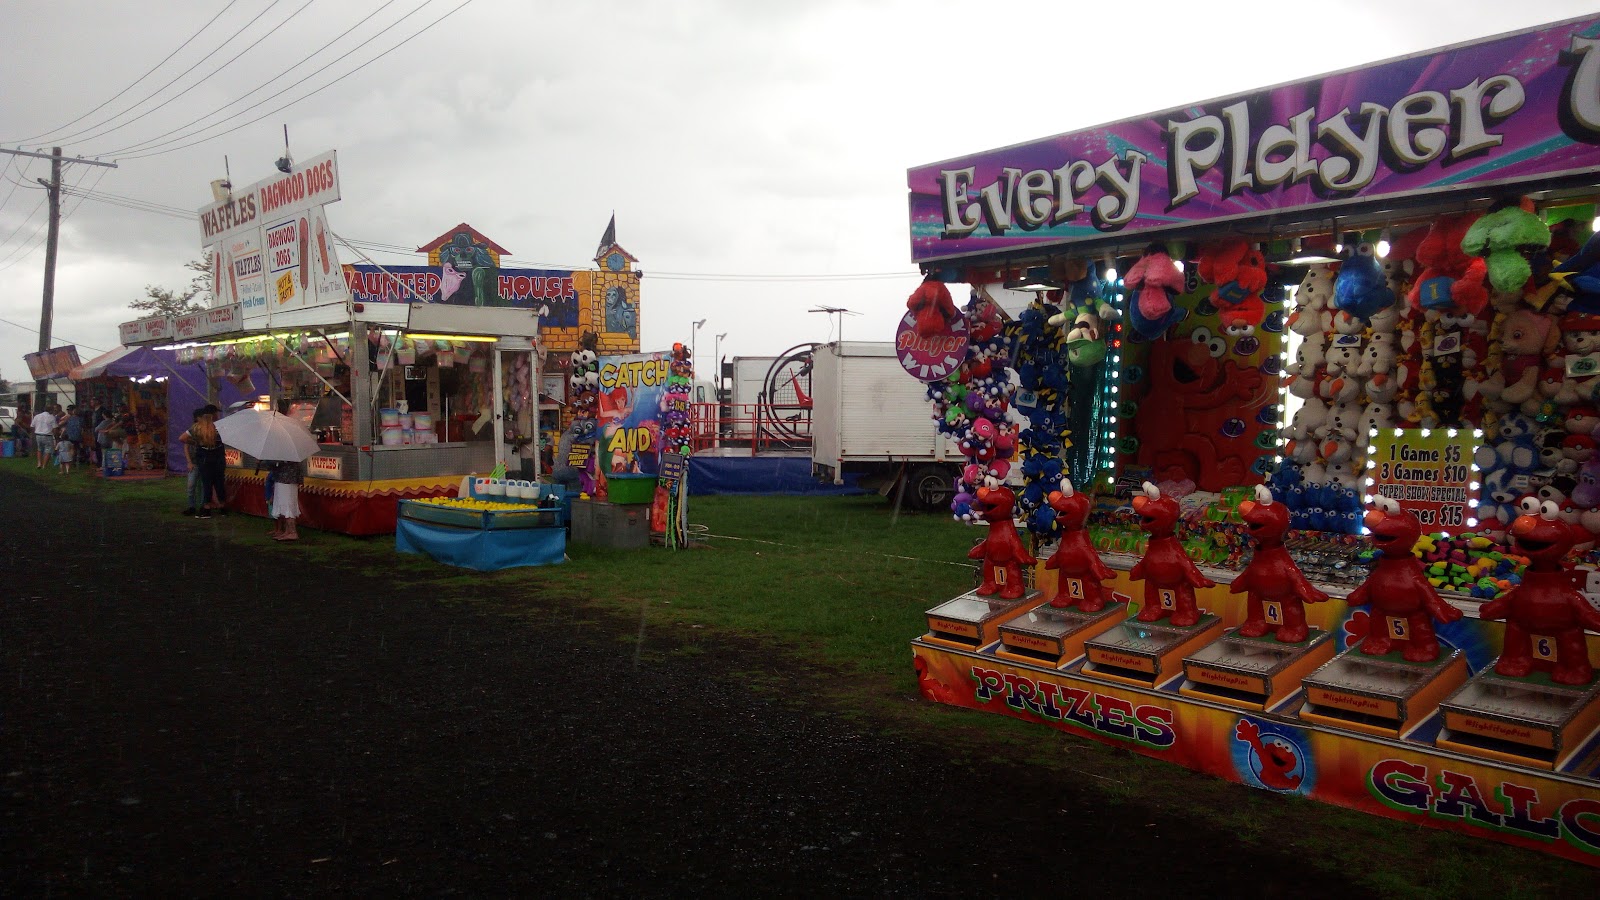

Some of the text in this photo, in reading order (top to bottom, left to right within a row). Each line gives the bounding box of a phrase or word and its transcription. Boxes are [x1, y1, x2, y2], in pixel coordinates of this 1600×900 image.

[940, 150, 1147, 236] Every
[1168, 74, 1526, 206] Player
[261, 160, 334, 214] DAGWOOD DOGS
[201, 193, 256, 238] WAFFLES
[267, 225, 296, 249] DAGWOOD
[276, 248, 291, 267] DOGS
[498, 274, 575, 300] HOUSE
[898, 330, 967, 357] Player
[600, 360, 670, 388] CATCH
[902, 352, 959, 378] WINS
[607, 426, 651, 453] AND
[1390, 444, 1461, 463] 1 Game $5
[1381, 463, 1467, 483] 3 Games $10
[1378, 484, 1467, 503] SUPER SHOW SPECIAL
[1439, 504, 1463, 527] $15
[998, 568, 1006, 584] 1
[1070, 580, 1080, 597] 2
[1163, 592, 1172, 608] 3
[1268, 603, 1278, 622] 4
[1392, 619, 1406, 636] 5
[1537, 639, 1551, 658] 6
[972, 666, 1176, 747] PRIZES
